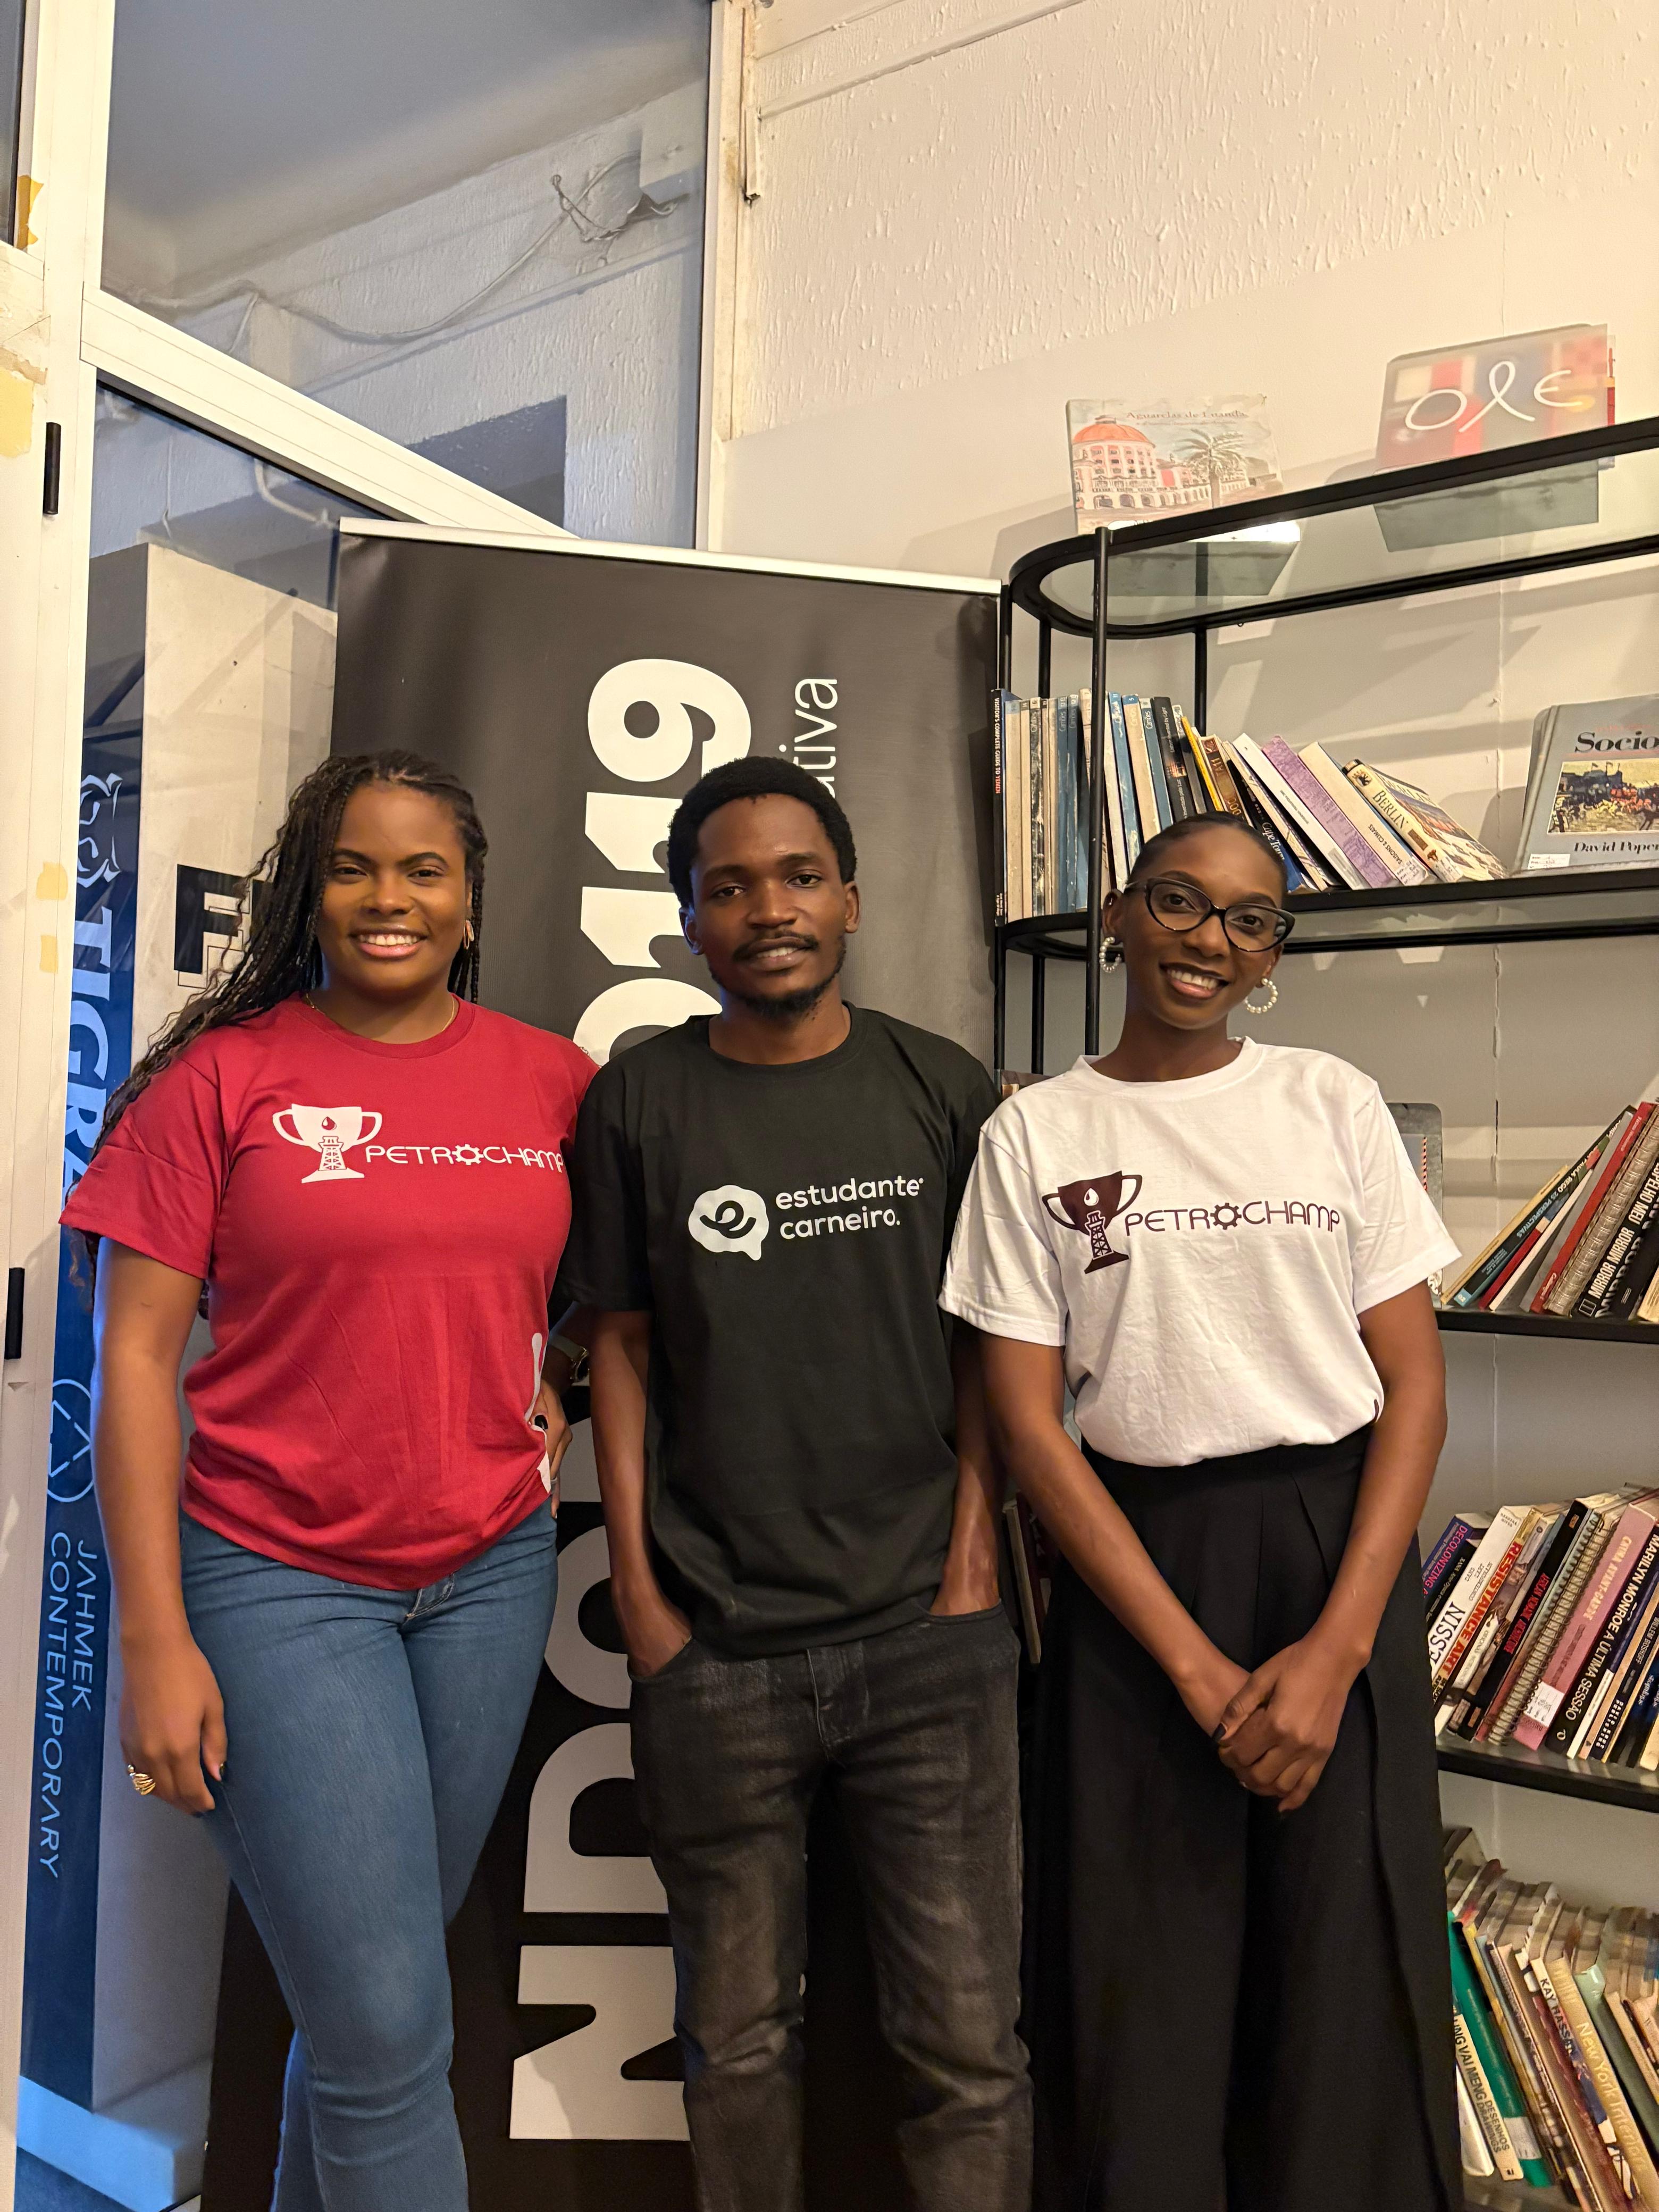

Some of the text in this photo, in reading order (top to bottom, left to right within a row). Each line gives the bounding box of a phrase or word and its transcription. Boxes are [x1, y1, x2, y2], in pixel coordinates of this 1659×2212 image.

[778, 678, 837, 797] tiva
[1574, 731, 1659, 752] Socio
[1372, 790, 1409, 830] BERLIN
[1574, 842, 1615, 852] David
[365, 1144, 565, 1173] PETROCHAMP
[1556, 1175, 1573, 1193] REGO
[780, 1206, 900, 1240] carneiro.
[1125, 1201, 1340, 1236] PETROCHAMP
[1515, 1198, 1553, 1238] PERSPECTIVAS
[1628, 1201, 1649, 1225] MEU
[1587, 1260, 1616, 1300] MIRROR
[1605, 1226, 1635, 1265] MIRROR
[1424, 1524, 1468, 1588] DECOLONIZING
[1631, 1534, 1659, 1584] MARILYN
[1457, 1540, 1523, 1643] RESISTANCE
[1582, 1535, 1633, 1621] CHINA AVANT-GARDE
[72, 1538, 98, 1713] JAHMEK
[1606, 1582, 1640, 1633] MONROE
[1603, 1630, 1615, 1641] A
[1439, 1639, 1466, 1677] ART
[1585, 1640, 1613, 1680] ÚLTIMA
[39, 1531, 71, 1879] CONTEMPORARY
[1563, 1677, 1595, 1722] SESSÃO
[1539, 1978, 1557, 2004] KAY
[1457, 2046, 1474, 2068] VAI
[1577, 2021, 1600, 2062] New
[1594, 2060, 1619, 2100] York
[1464, 2067, 1488, 2101] MENG
[1476, 2101, 1502, 2154] DRAWINGS
[1484, 2100, 1511, 2151] DESENHOS
